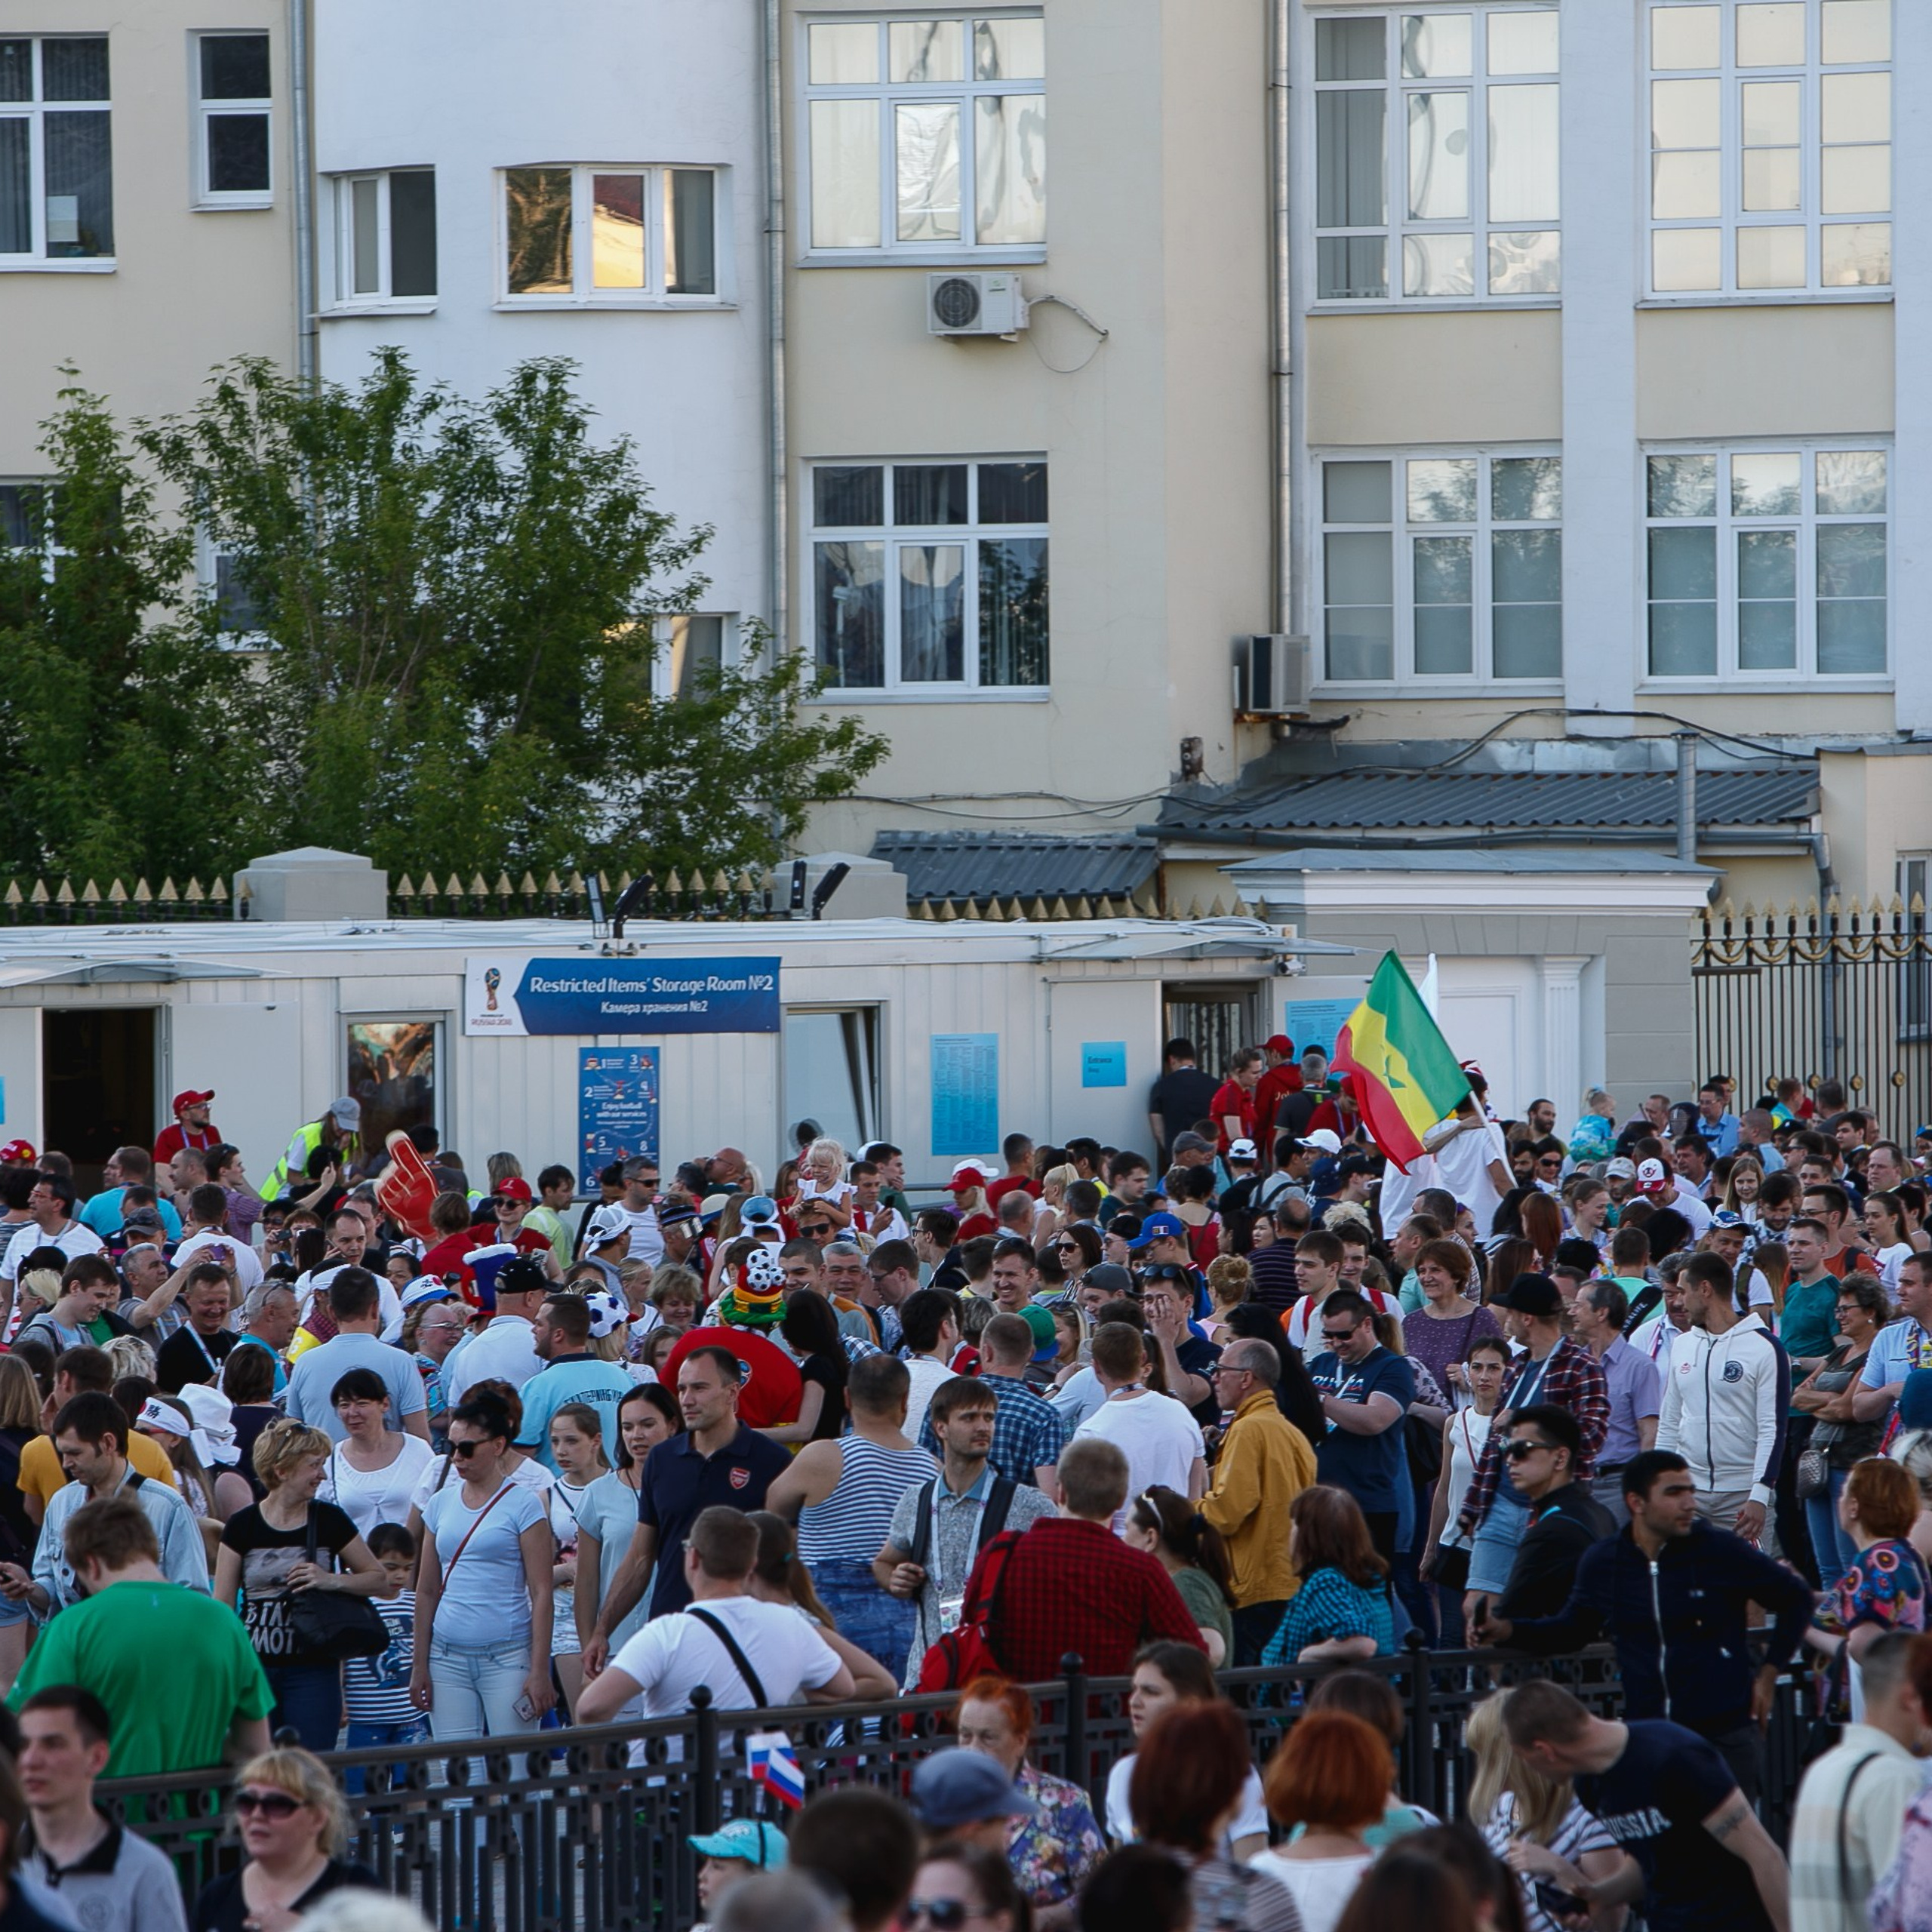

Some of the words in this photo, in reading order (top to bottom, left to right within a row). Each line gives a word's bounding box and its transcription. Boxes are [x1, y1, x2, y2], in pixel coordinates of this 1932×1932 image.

[530, 977, 606, 993] Restricted
[608, 977, 651, 993] Items'
[651, 977, 706, 995] Storage
[706, 976, 746, 992] Room
[601, 1001, 641, 1015] Камера
[641, 1003, 688, 1015] хранения
[630, 1054, 638, 1065] 3
[584, 1087, 593, 1098] 2
[598, 1136, 606, 1147] 5
[639, 1140, 648, 1152] 8
[585, 1176, 595, 1187] 6
